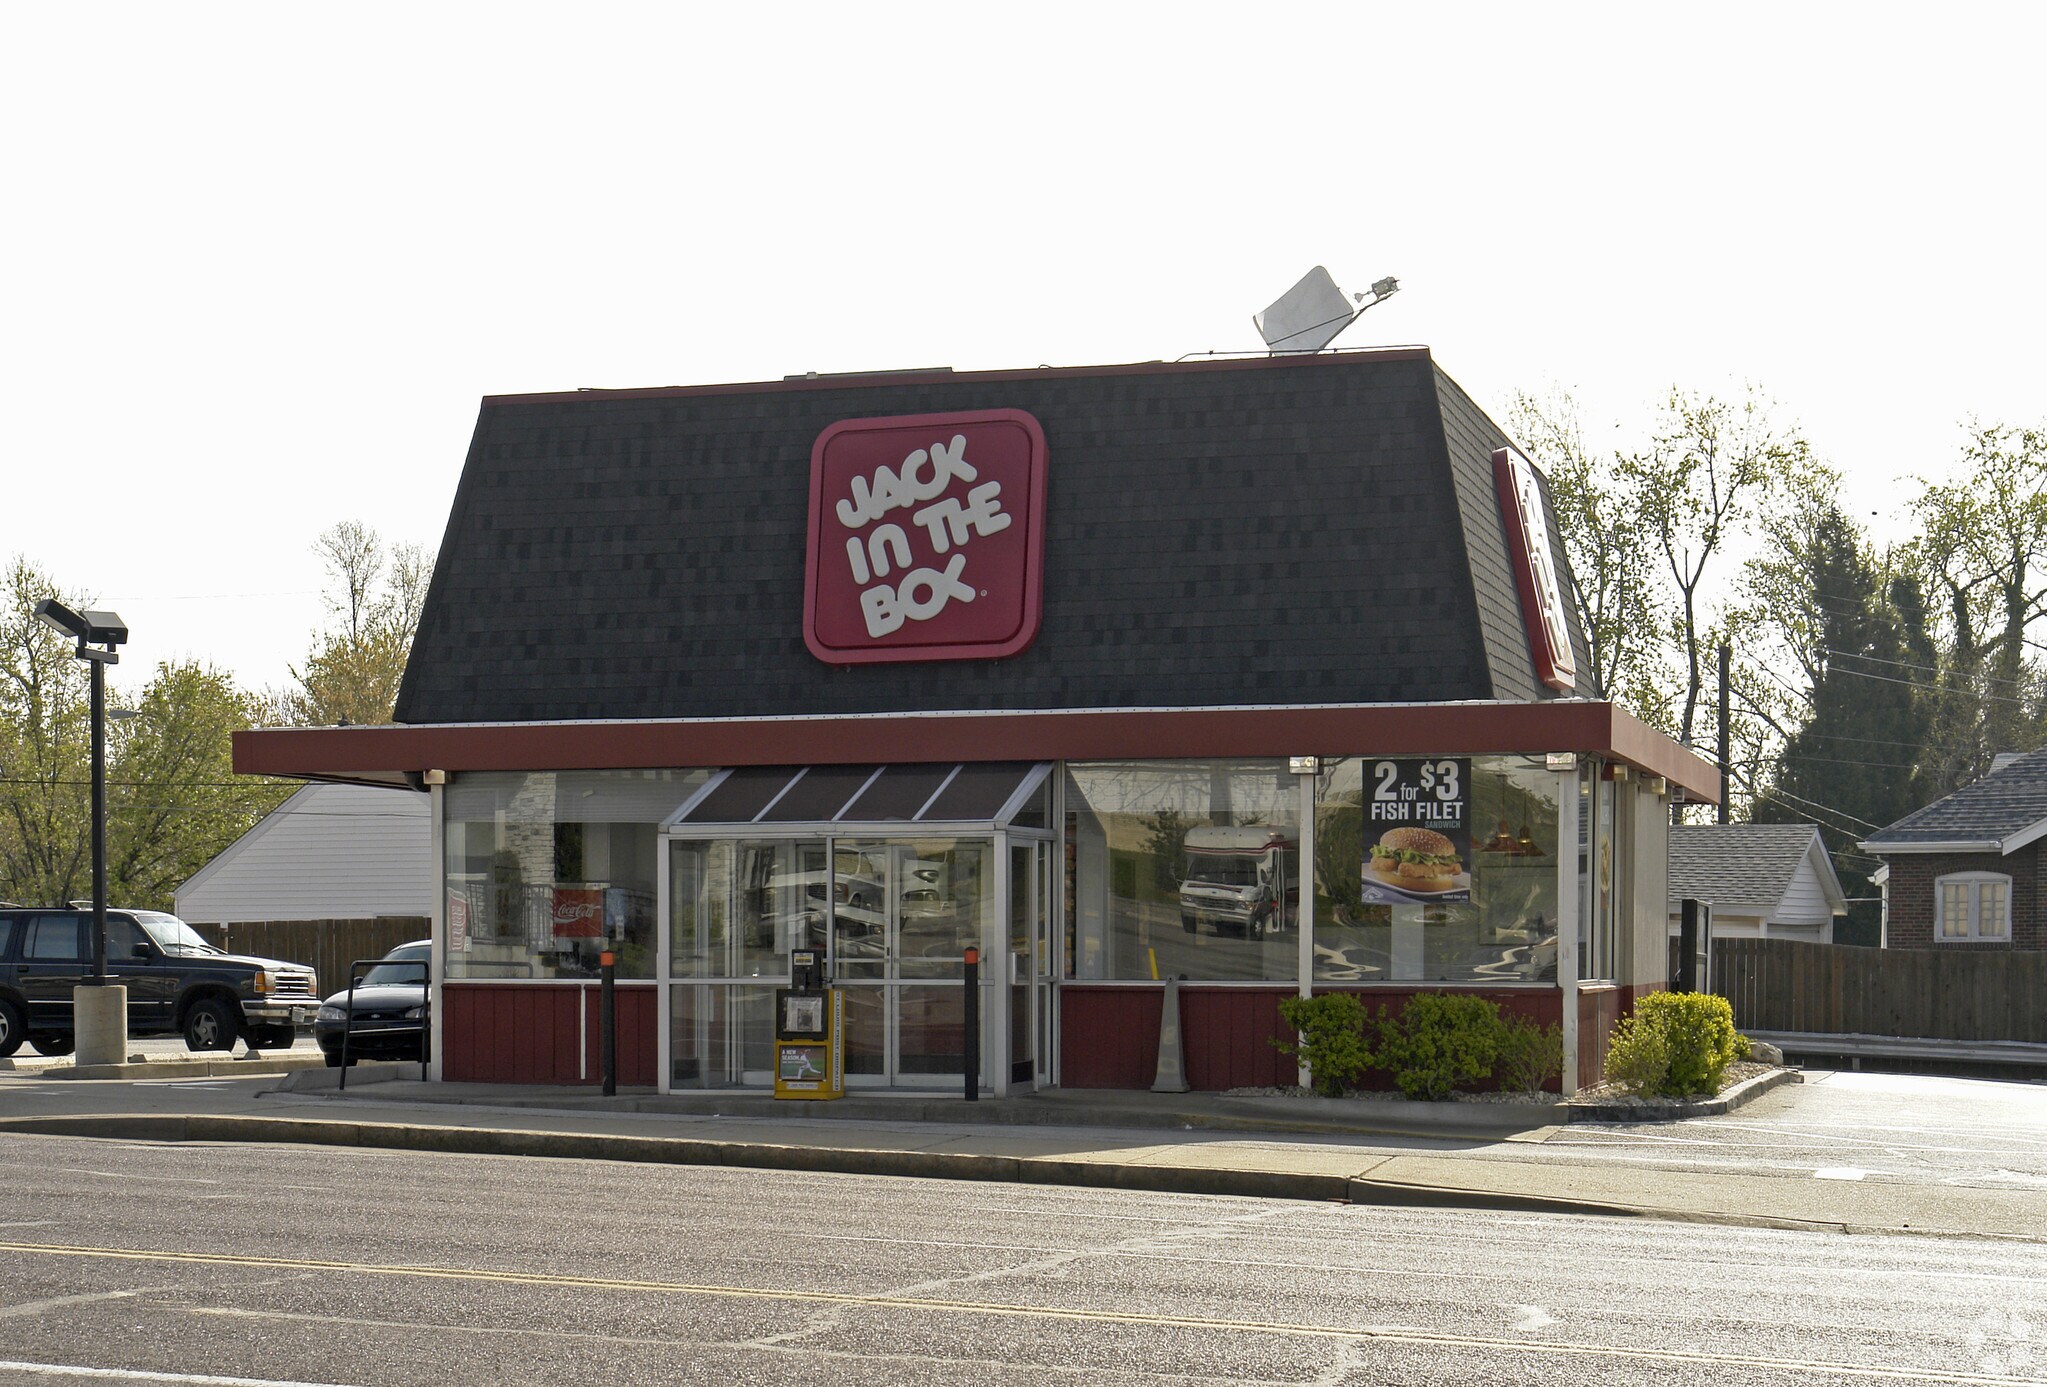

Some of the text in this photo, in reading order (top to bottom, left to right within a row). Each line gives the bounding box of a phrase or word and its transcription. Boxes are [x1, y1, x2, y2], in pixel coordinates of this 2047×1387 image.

[836, 434, 978, 529] JACK
[912, 480, 1012, 554] THE
[859, 553, 976, 639] BOX
[1374, 760, 1459, 801] 2 for $3
[1371, 802, 1463, 820] FISH FILET
[1424, 820, 1461, 829] SANDWICH
[558, 903, 601, 918] Coca-Cola
